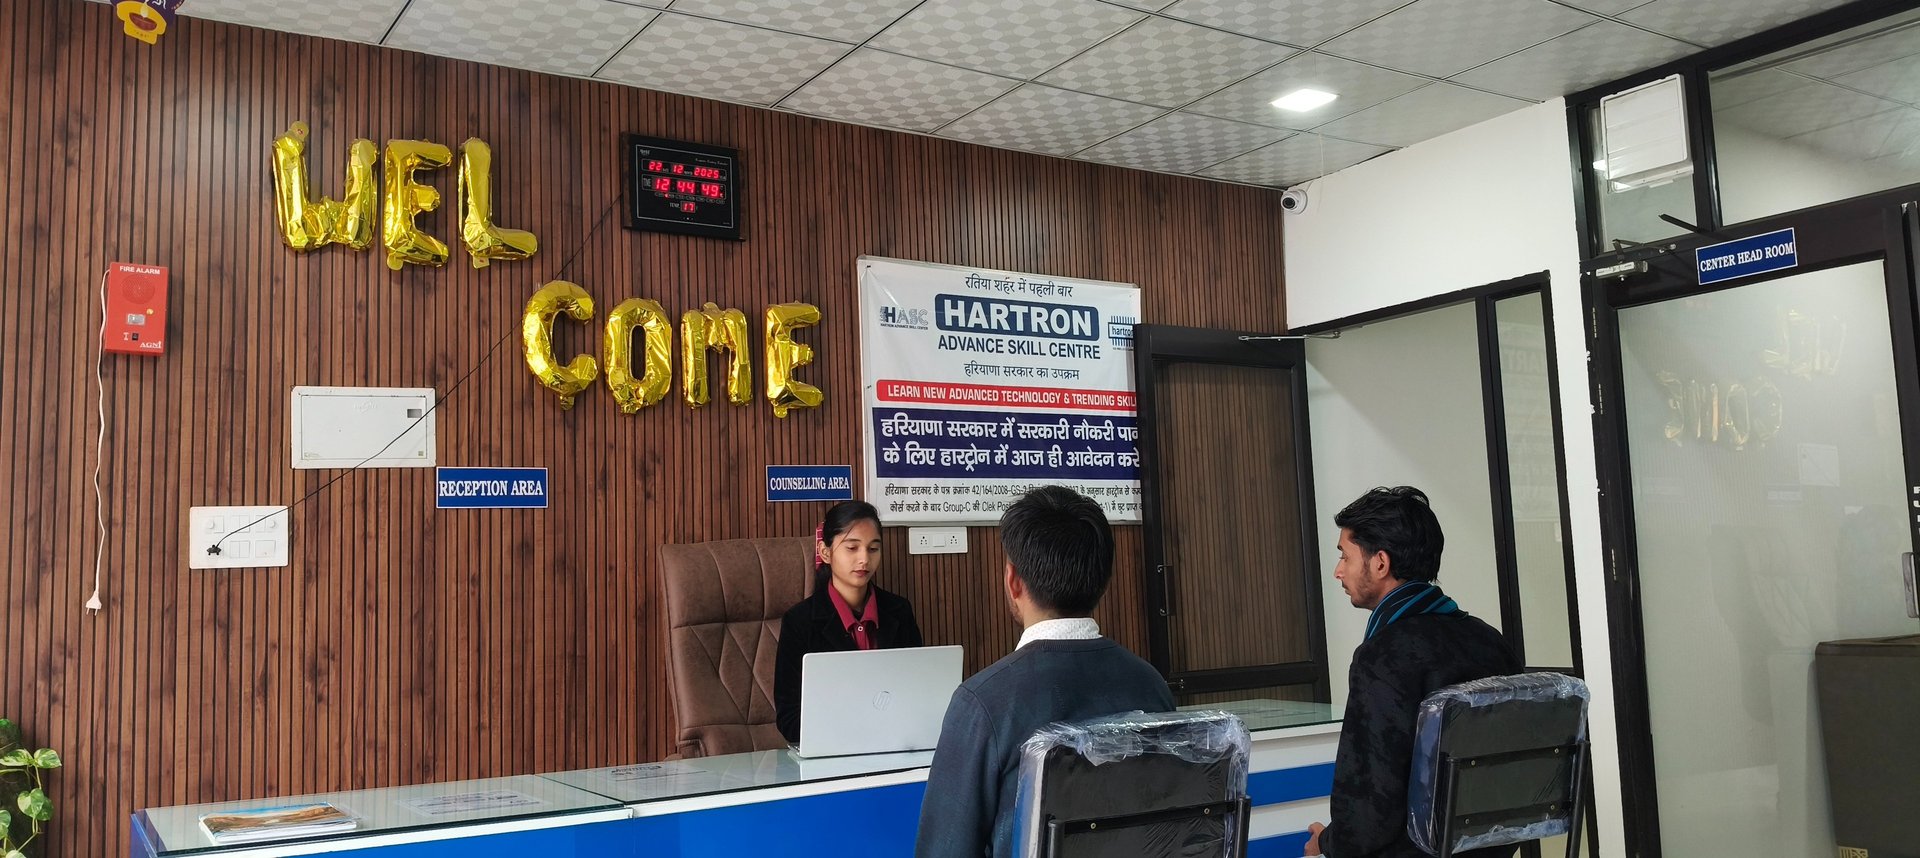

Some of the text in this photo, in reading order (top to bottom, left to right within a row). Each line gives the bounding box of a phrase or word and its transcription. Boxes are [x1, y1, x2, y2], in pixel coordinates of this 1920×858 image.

[648, 161, 663, 171] 22
[673, 164, 684, 174] 12
[694, 167, 720, 180] 2025
[272, 121, 538, 270] WEL
[655, 178, 671, 191] 12
[676, 180, 696, 194] 44
[701, 184, 719, 197] 49
[683, 203, 694, 211] 17
[1700, 242, 1794, 272] CENTER HEAD ROOM
[136, 267, 160, 275] ALARM
[965, 273, 1073, 297] रतिया शहर में पहली बार
[944, 299, 1092, 337] HARTRON
[522, 280, 824, 418] COME
[938, 334, 1101, 360] ADVANCE SKILL CENTRE
[964, 360, 1080, 380] हरियाणा सरकार का उपक्रम
[888, 384, 921, 398] LEARN
[923, 386, 946, 399] NEW
[949, 387, 999, 402] ADVANCED
[1001, 390, 1061, 404] TECHNOLOGY
[1064, 393, 1070, 403] &
[1072, 393, 1115, 406] TRENDING
[881, 412, 943, 437] हरियाणा
[946, 421, 998, 438] सरकार
[1000, 416, 1016, 438] में
[1017, 418, 1070, 440] सरकारी
[1073, 418, 1114, 441] नौकरी
[883, 441, 900, 464] के
[905, 441, 937, 465] लिए
[940, 443, 990, 472] हारट्रोन
[994, 443, 1010, 465] में
[1011, 450, 1044, 466] आज
[1047, 444, 1063, 468] ही
[1066, 446, 1115, 467] आवेदन
[439, 480, 544, 496] RECEPTION AREA
[770, 476, 850, 490] COUNSELLING AREA
[885, 483, 909, 496] हरियाणा
[911, 486, 932, 496] सरकार
[933, 484, 940, 495] के
[941, 486, 951, 495] पत्र
[1080, 484, 1086, 495] के
[1124, 485, 1130, 496] से
[922, 501, 929, 512] के
[930, 503, 942, 512] बाद
[943, 501, 971, 514] Group-C
[972, 500, 980, 512] की
